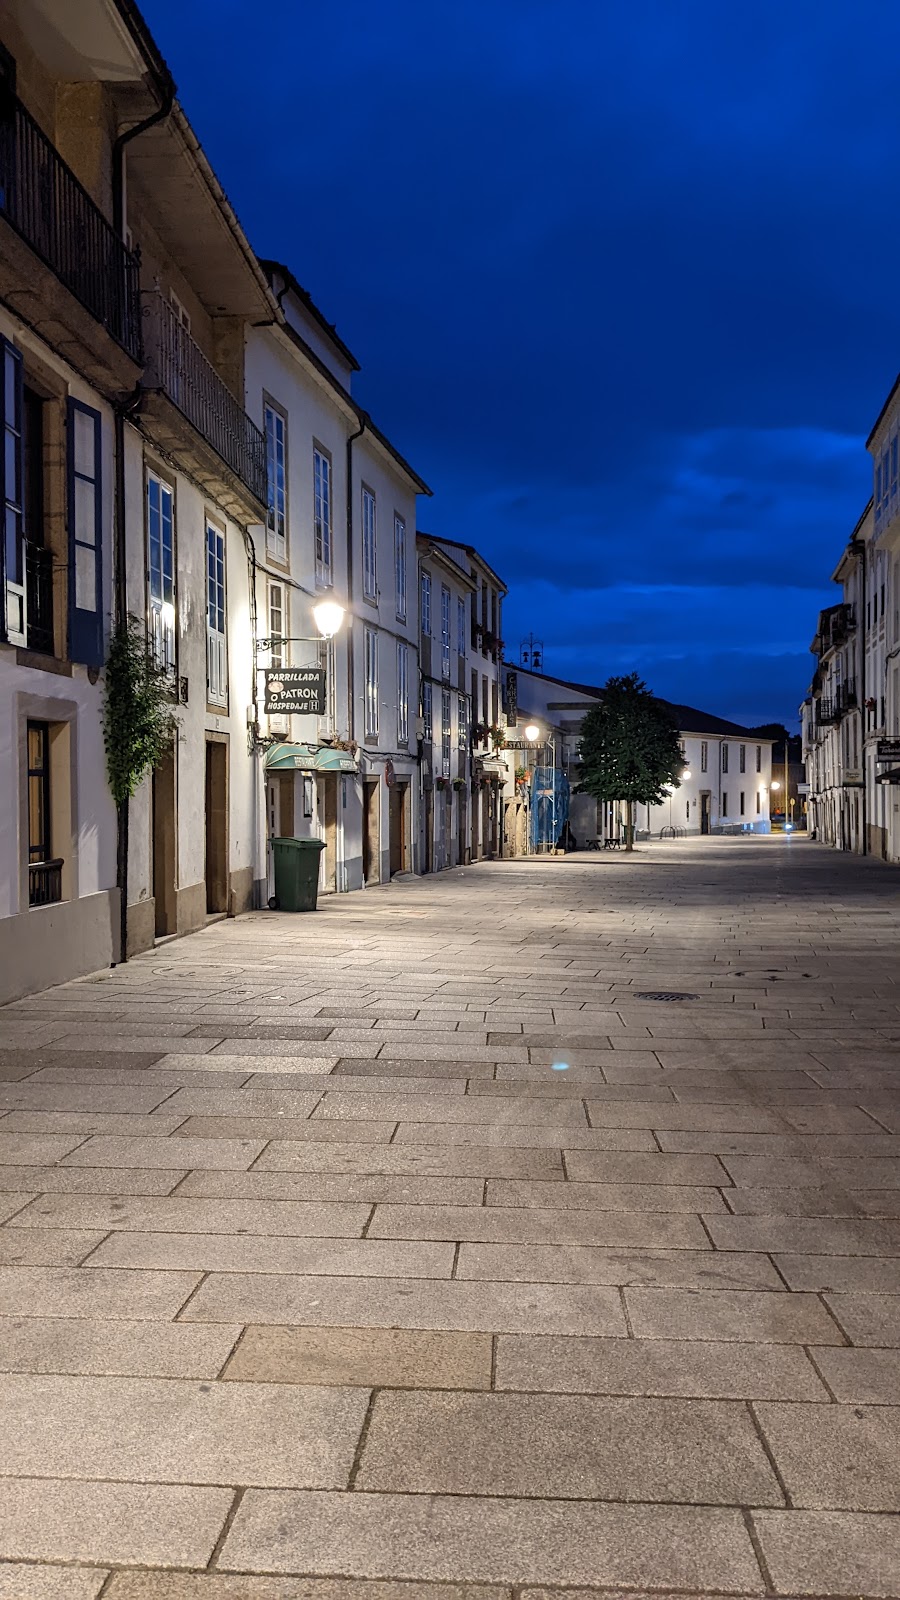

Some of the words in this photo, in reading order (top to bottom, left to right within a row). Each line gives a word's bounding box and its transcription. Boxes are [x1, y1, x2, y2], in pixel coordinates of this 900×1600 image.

[268, 673, 319, 681] PARRILLADA
[270, 694, 278, 702] O
[280, 688, 318, 699] PATRON
[502, 741, 544, 749] STAURANTE
